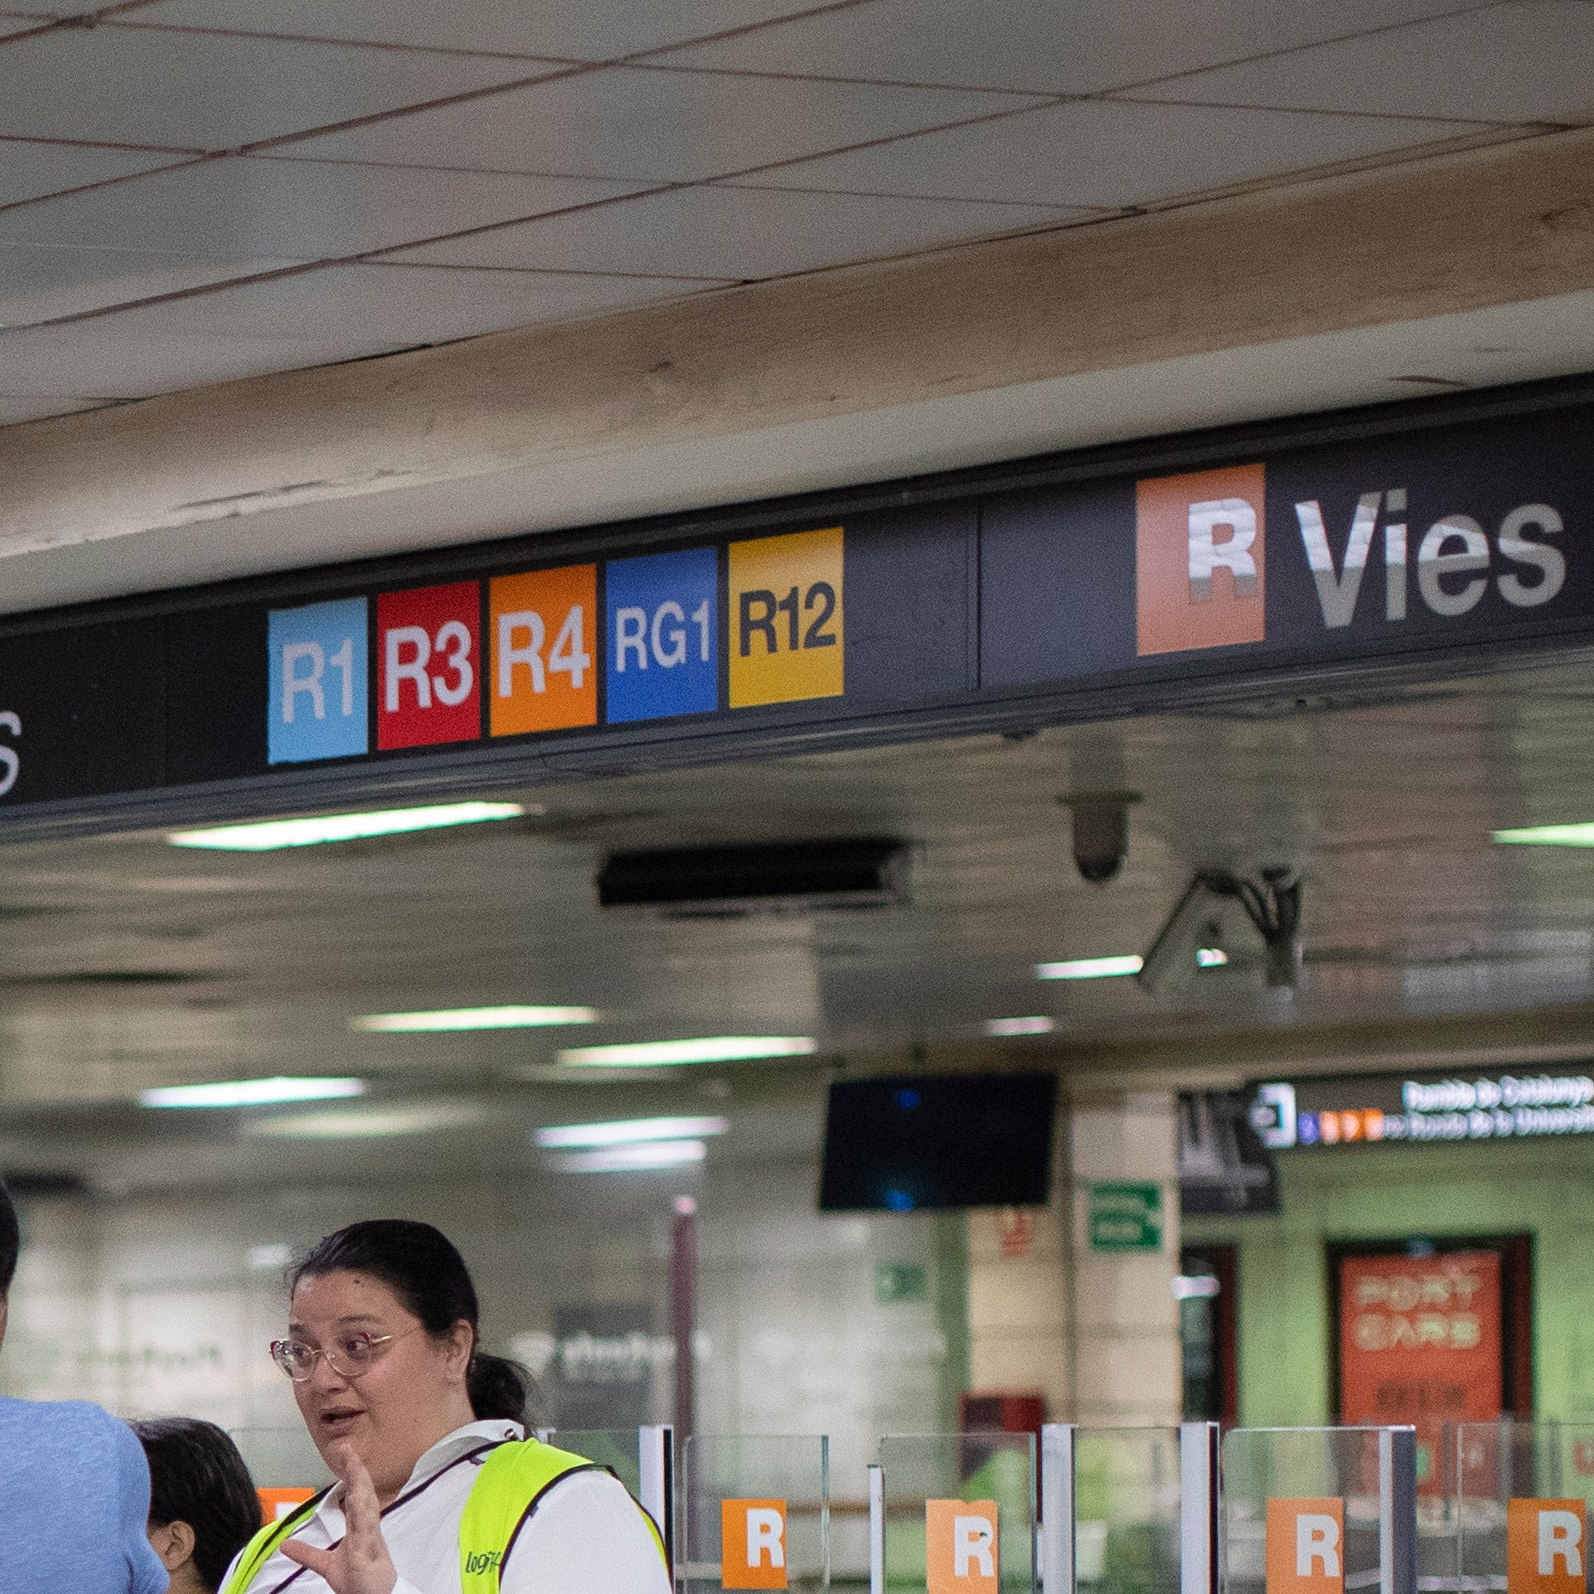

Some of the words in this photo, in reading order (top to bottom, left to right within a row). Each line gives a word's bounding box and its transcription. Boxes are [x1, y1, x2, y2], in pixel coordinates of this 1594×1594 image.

[1187, 497, 1258, 604] R
[1294, 488, 1567, 629] Vies
[281, 639, 355, 724] R1
[384, 620, 474, 714] R3
[497, 604, 591, 698] R4
[614, 599, 710, 674] RG1
[738, 581, 838, 658] R12
[746, 1507, 786, 1568] R
[953, 1515, 995, 1578] R
[1295, 1513, 1341, 1577] R
[1537, 1509, 1583, 1577] R
